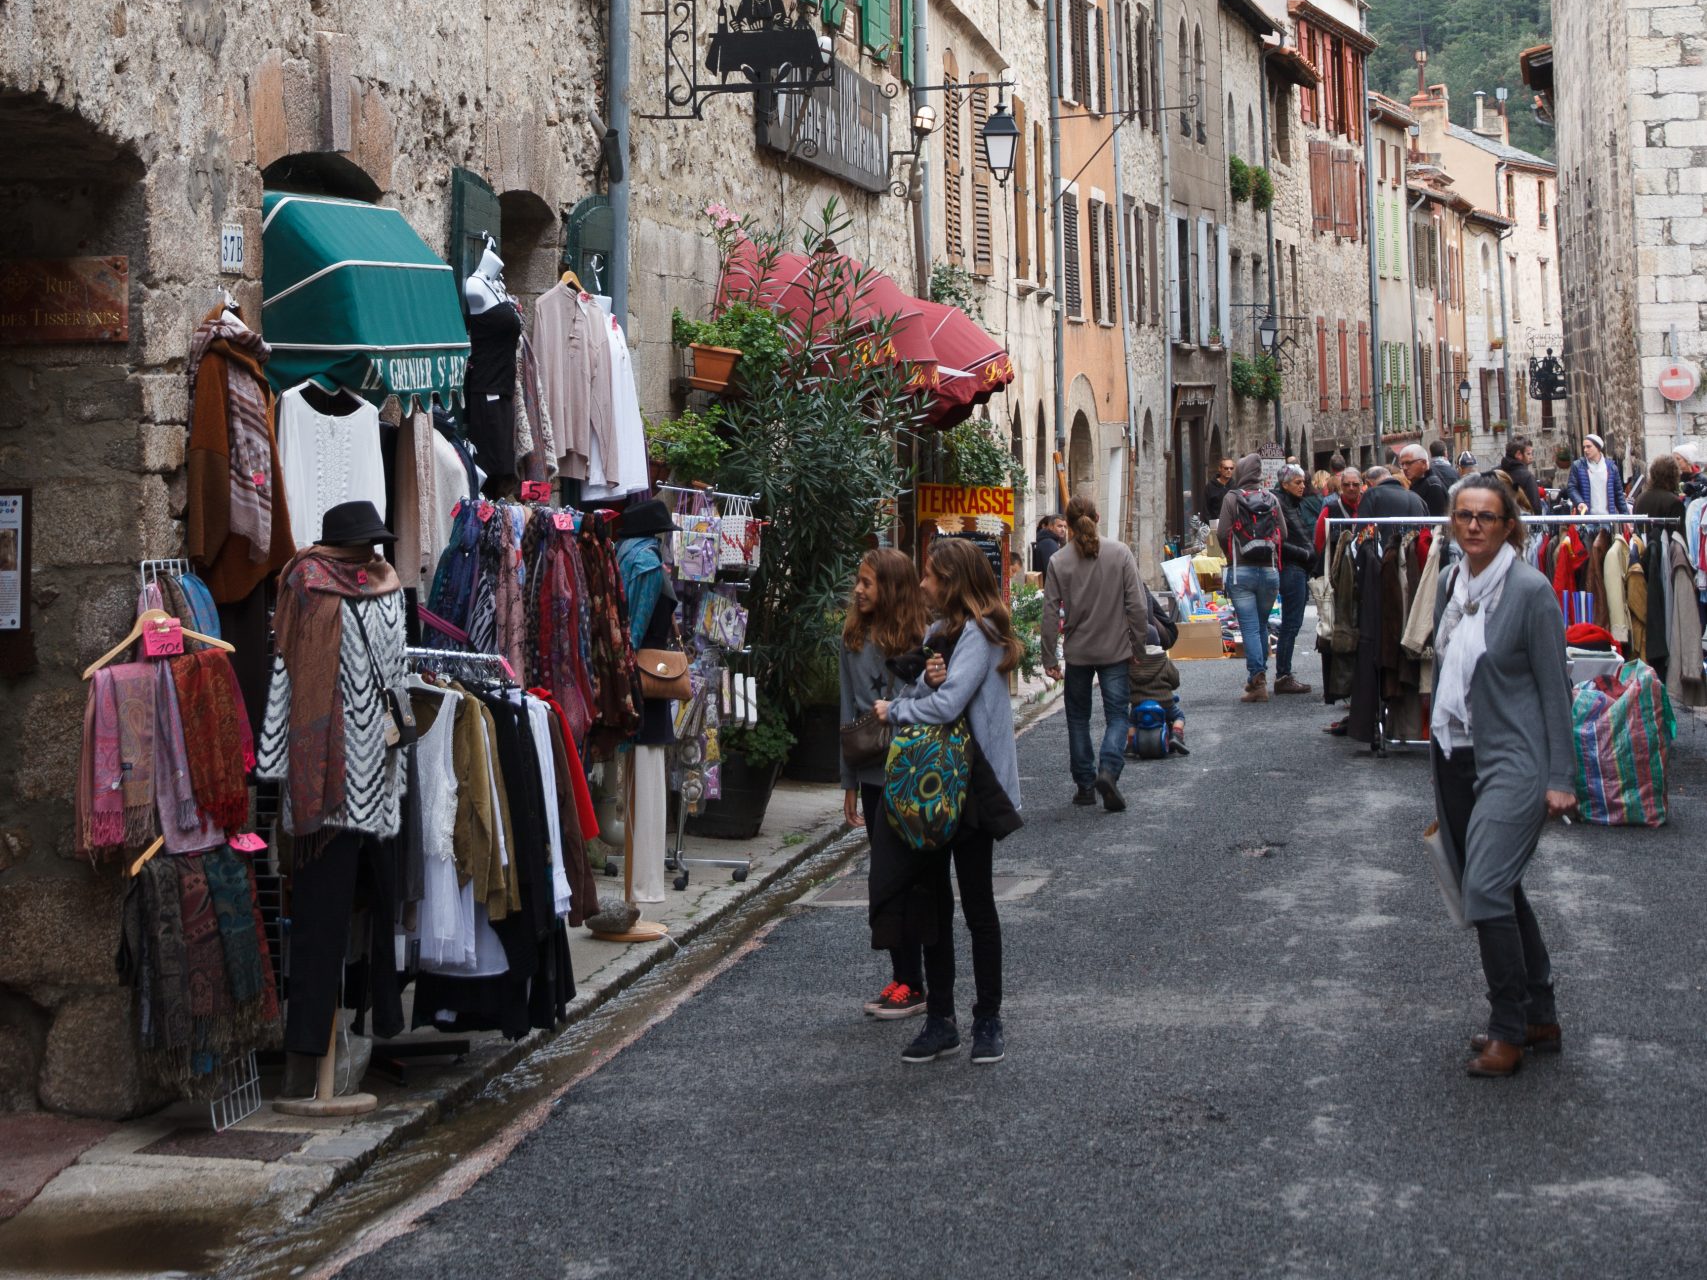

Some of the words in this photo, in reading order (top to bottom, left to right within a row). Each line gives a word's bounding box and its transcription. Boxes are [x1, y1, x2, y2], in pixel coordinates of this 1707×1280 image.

[223, 235, 243, 262] 37B
[361, 358, 384, 389] LE
[389, 357, 433, 390] GRENIER
[920, 486, 1014, 516] TERRASSE
